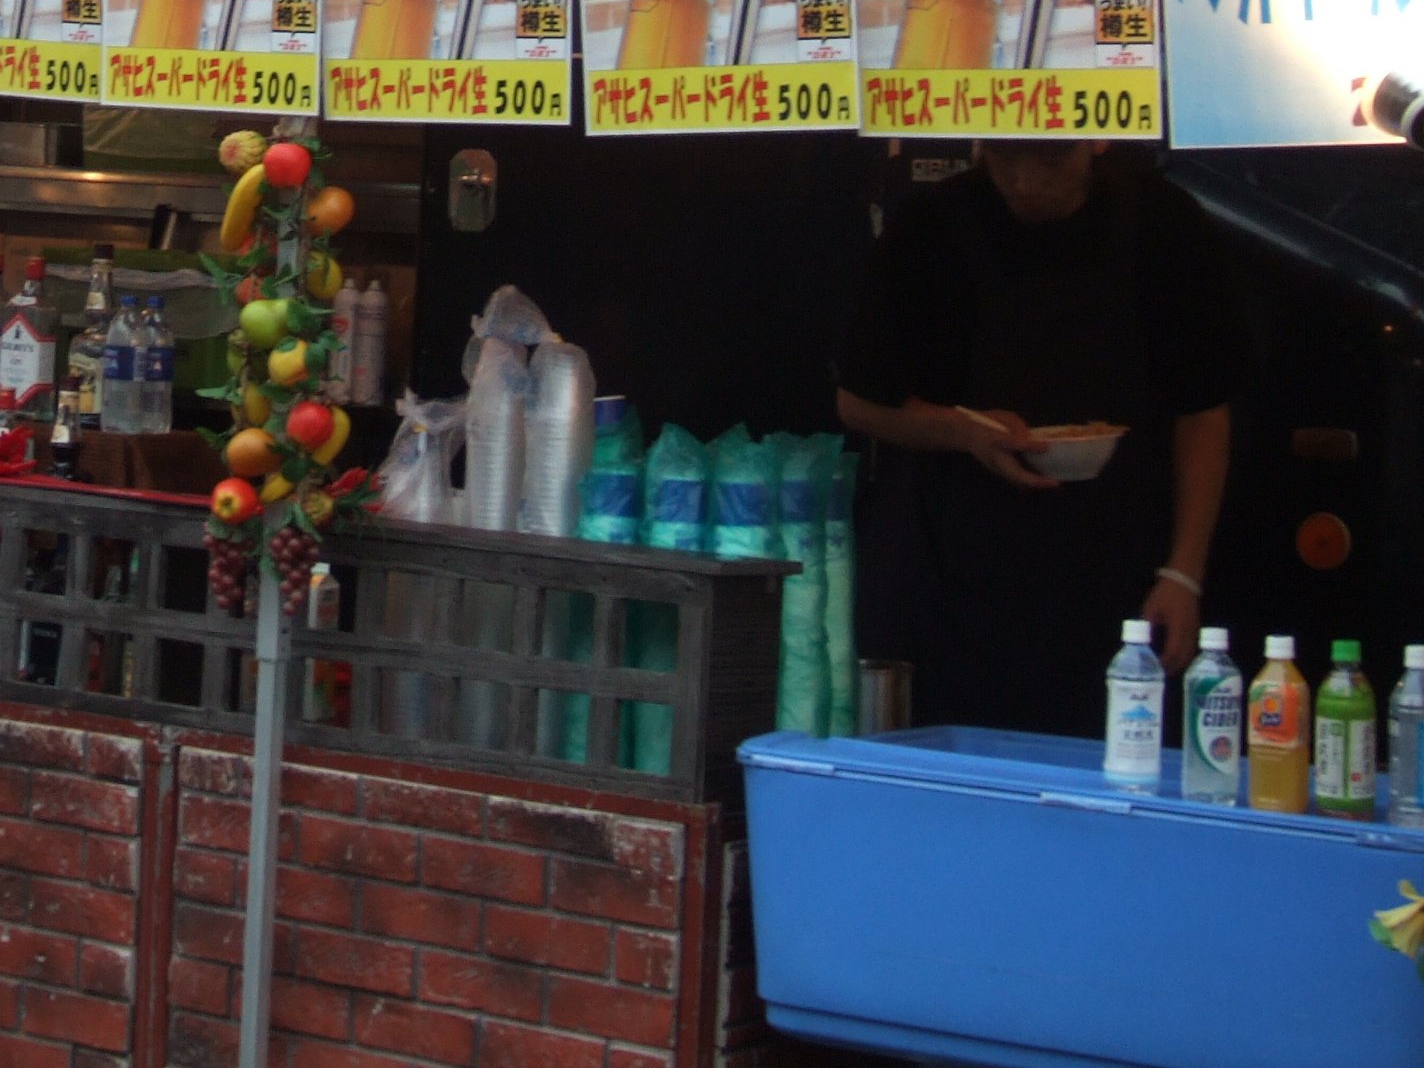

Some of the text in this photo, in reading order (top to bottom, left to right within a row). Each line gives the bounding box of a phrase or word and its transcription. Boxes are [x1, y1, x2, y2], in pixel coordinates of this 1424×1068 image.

[45, 59, 99, 96] 500円
[252, 70, 312, 109] 500円
[494, 79, 562, 117] 500円
[777, 82, 850, 122] 500円
[1073, 90, 1152, 130] 500円
